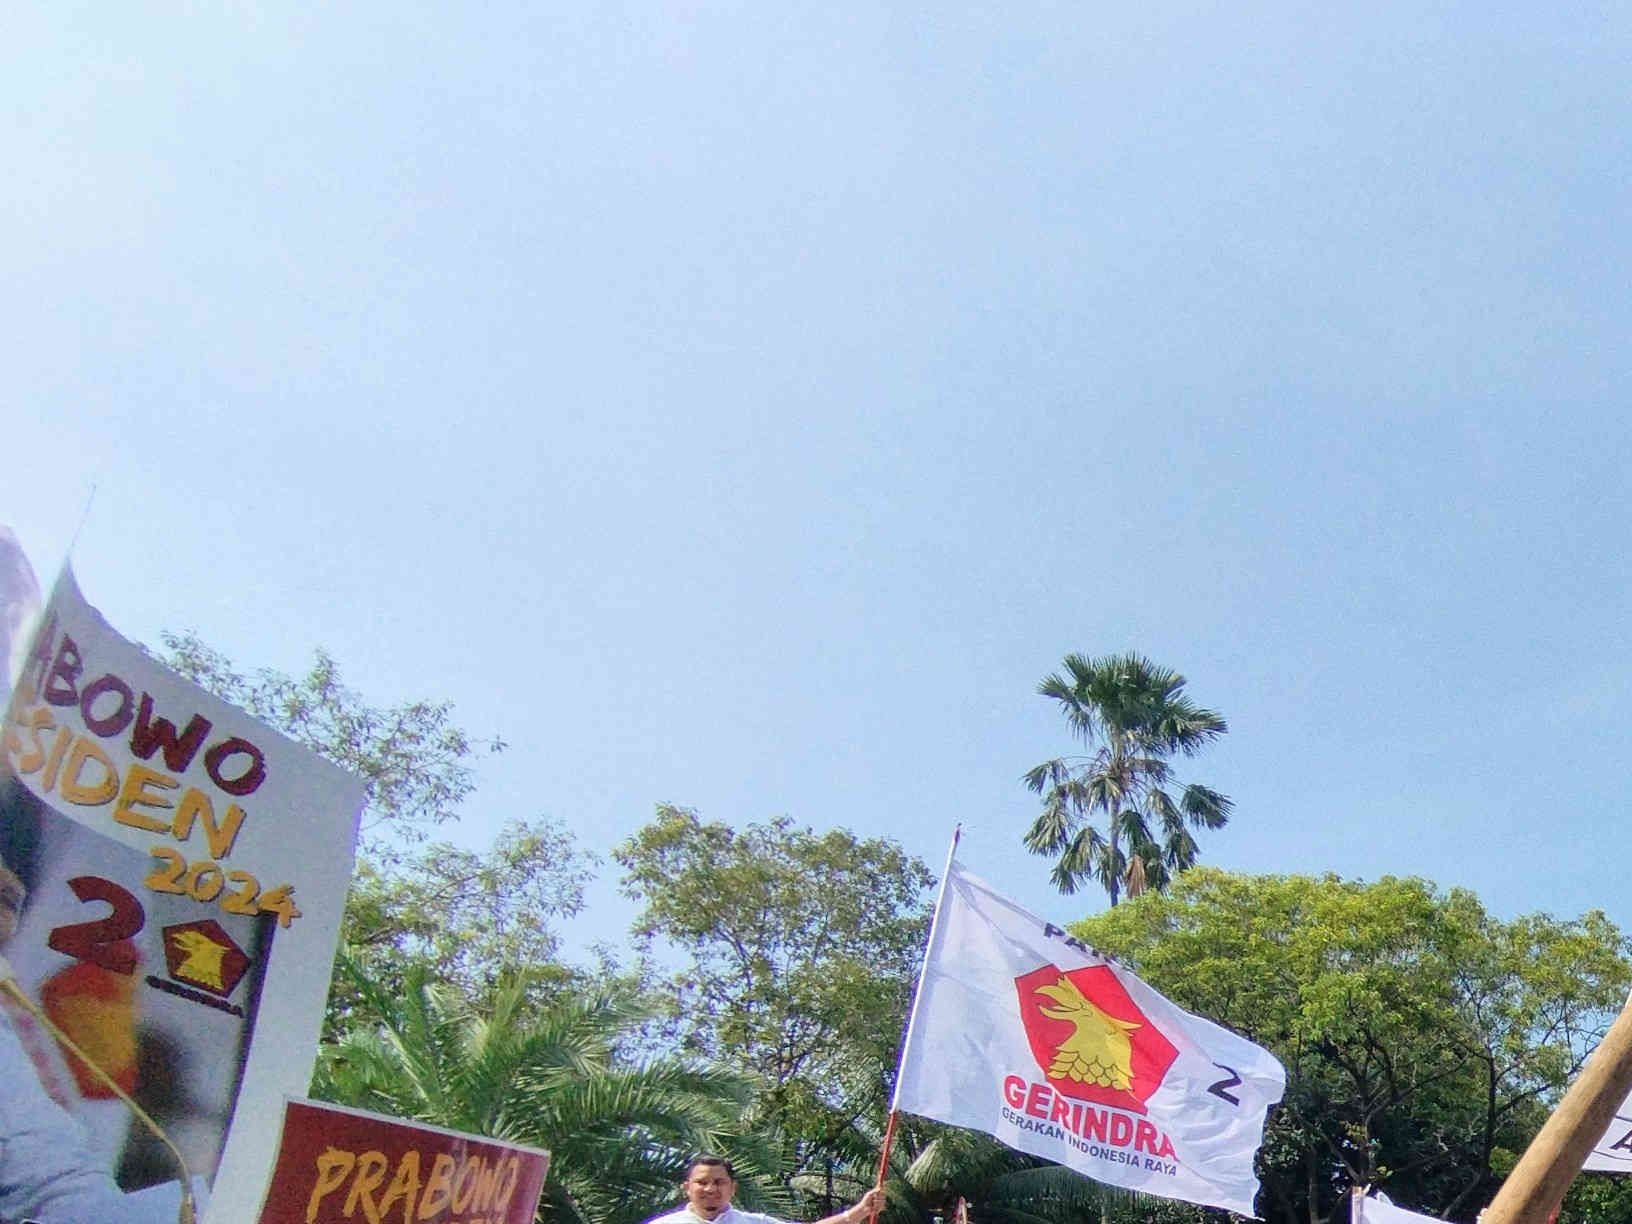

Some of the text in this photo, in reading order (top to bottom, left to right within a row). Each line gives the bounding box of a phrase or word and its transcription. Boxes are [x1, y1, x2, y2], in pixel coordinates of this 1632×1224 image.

[48, 876, 146, 974] 2
[142, 847, 303, 929] 2024
[1002, 1106, 1178, 1177] GERAKAN INDONESIA RAYA
[1004, 1074, 1180, 1163] GERINDRA
